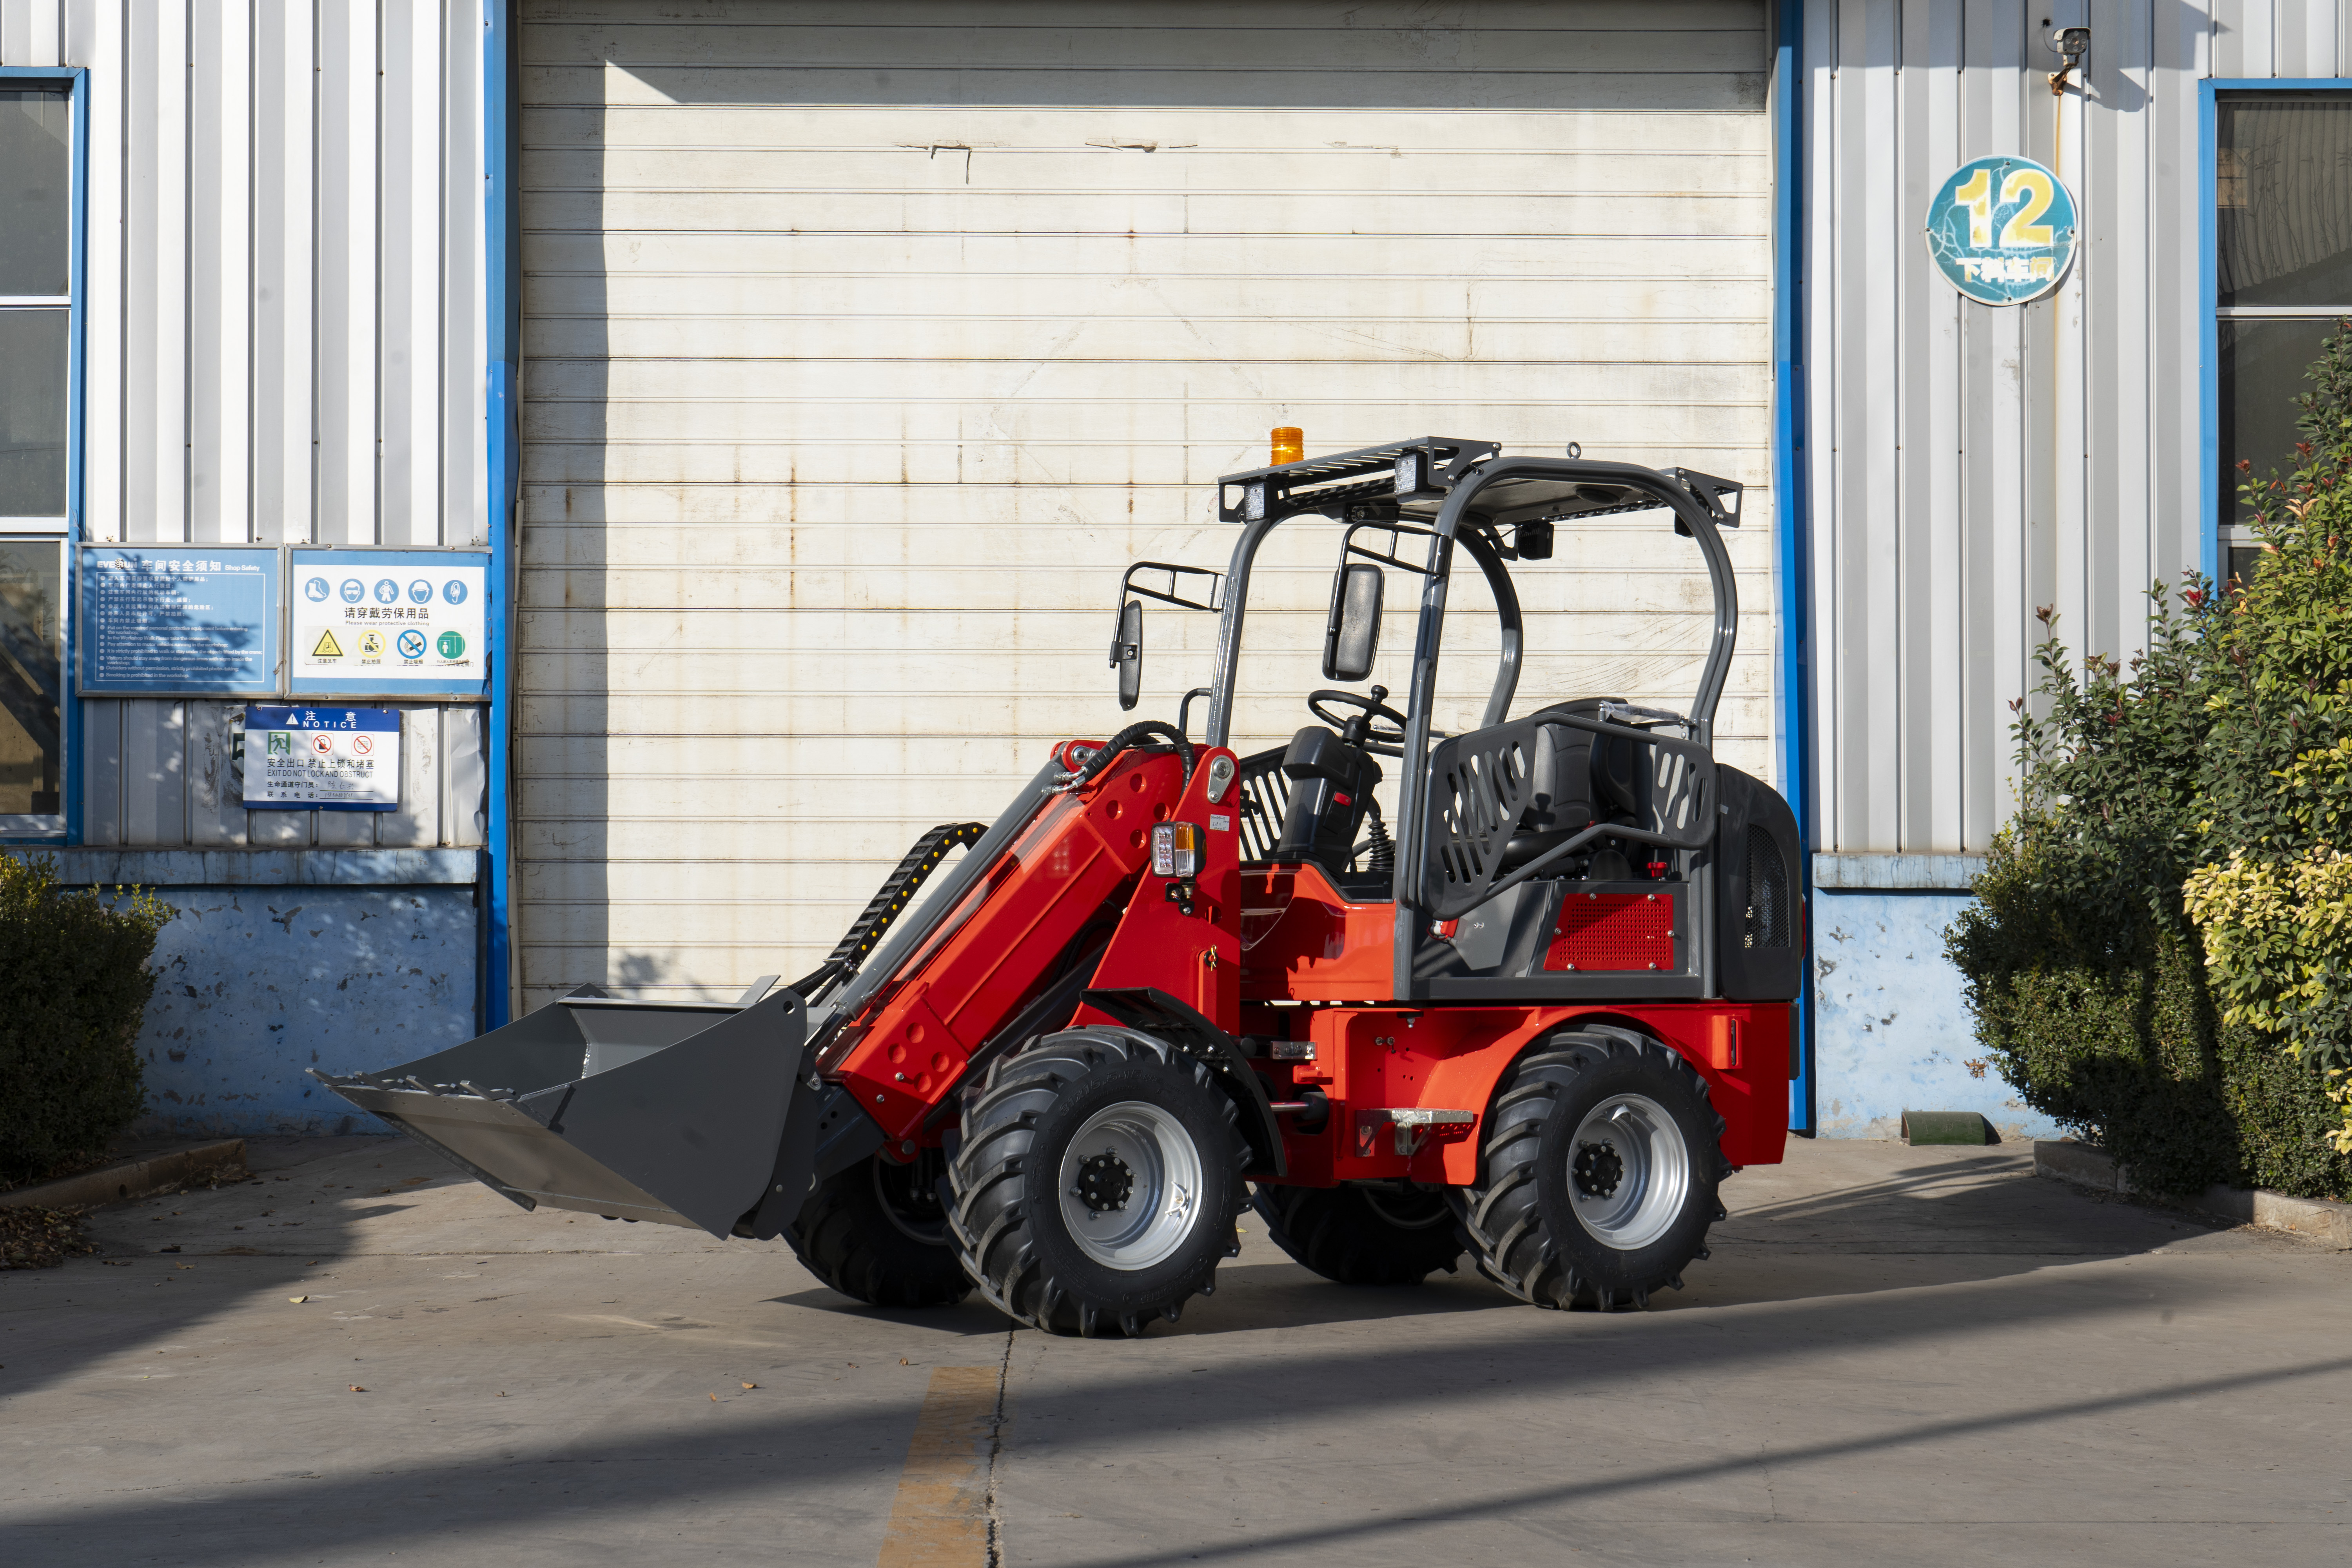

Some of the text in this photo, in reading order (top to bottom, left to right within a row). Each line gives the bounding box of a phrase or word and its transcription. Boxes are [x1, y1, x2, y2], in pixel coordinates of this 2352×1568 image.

[1955, 169, 2054, 247] 12
[97, 559, 137, 569] EVERUN
[141, 559, 221, 572] 车间安全须知
[345, 607, 429, 619] 请穿戴劳保用品
[267, 758, 374, 769] 安全出口 禁止上锁和堵塞
